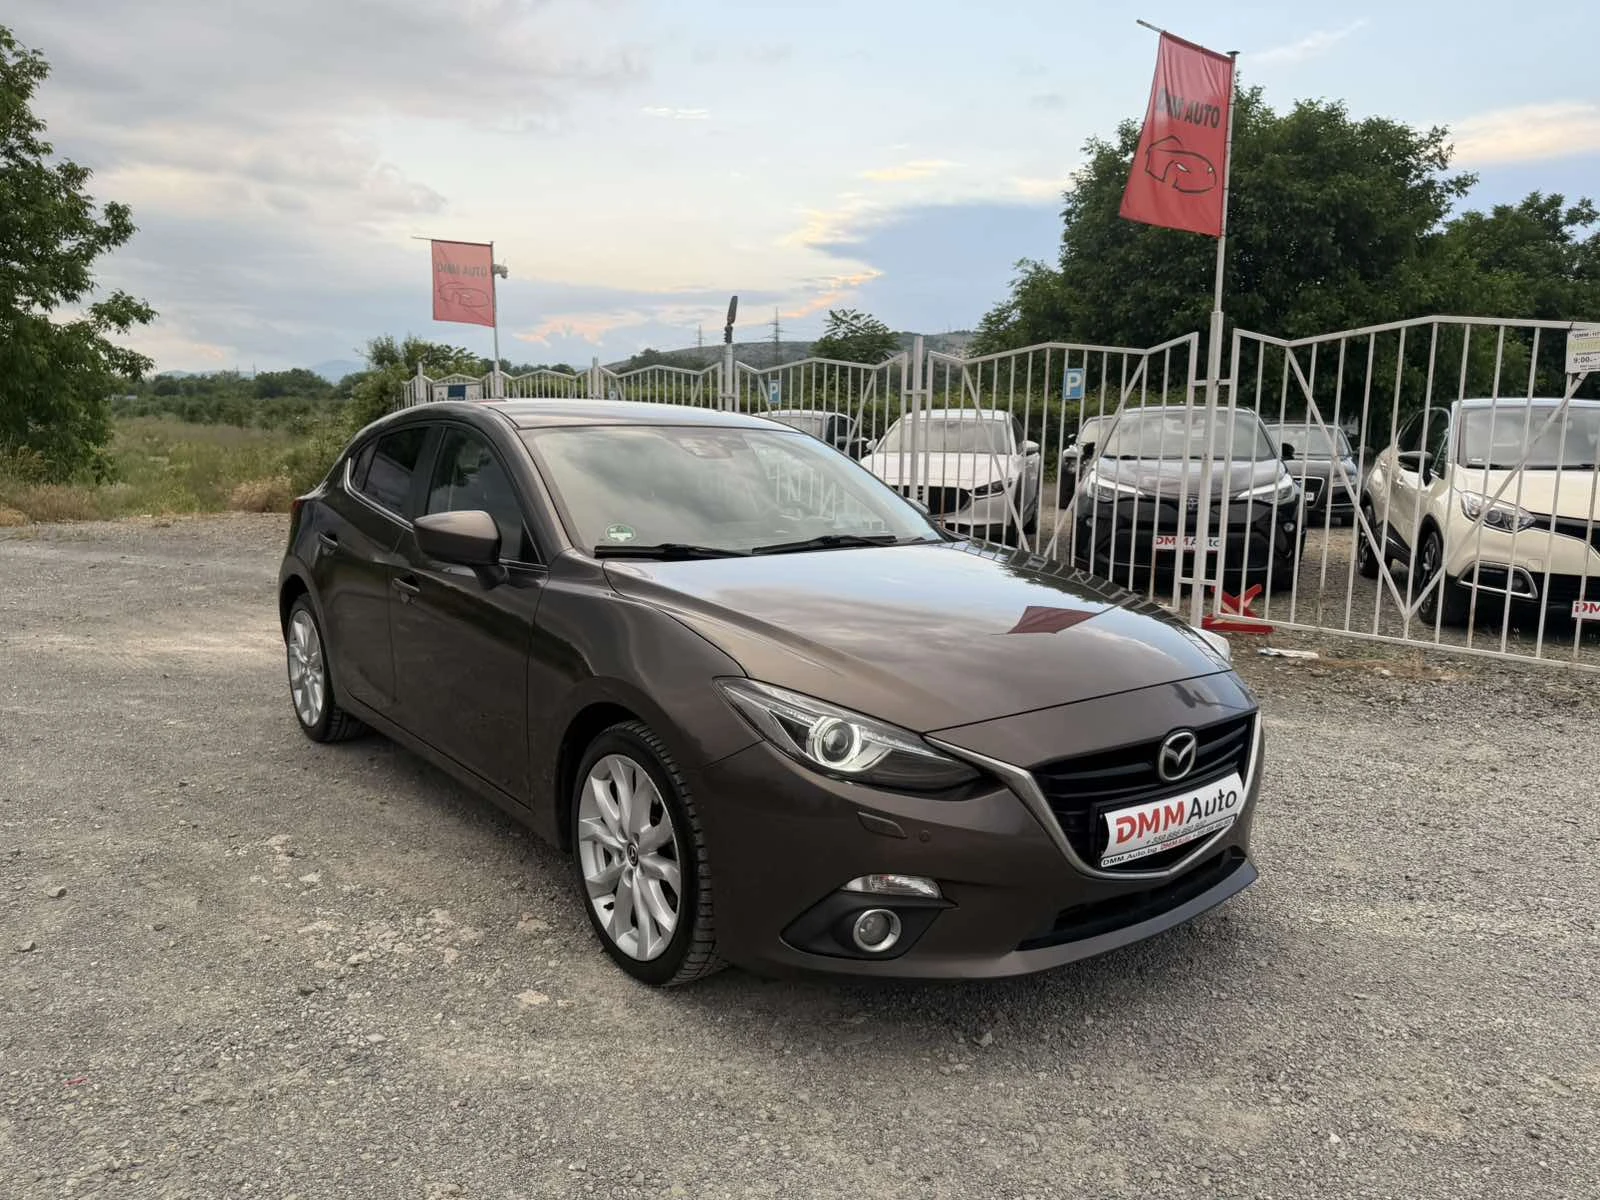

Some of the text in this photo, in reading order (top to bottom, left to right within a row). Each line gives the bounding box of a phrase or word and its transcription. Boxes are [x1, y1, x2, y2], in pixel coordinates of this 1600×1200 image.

[1184, 100, 1220, 128] AUTO
[769, 382, 779, 401] P
[1066, 371, 1082, 396] P
